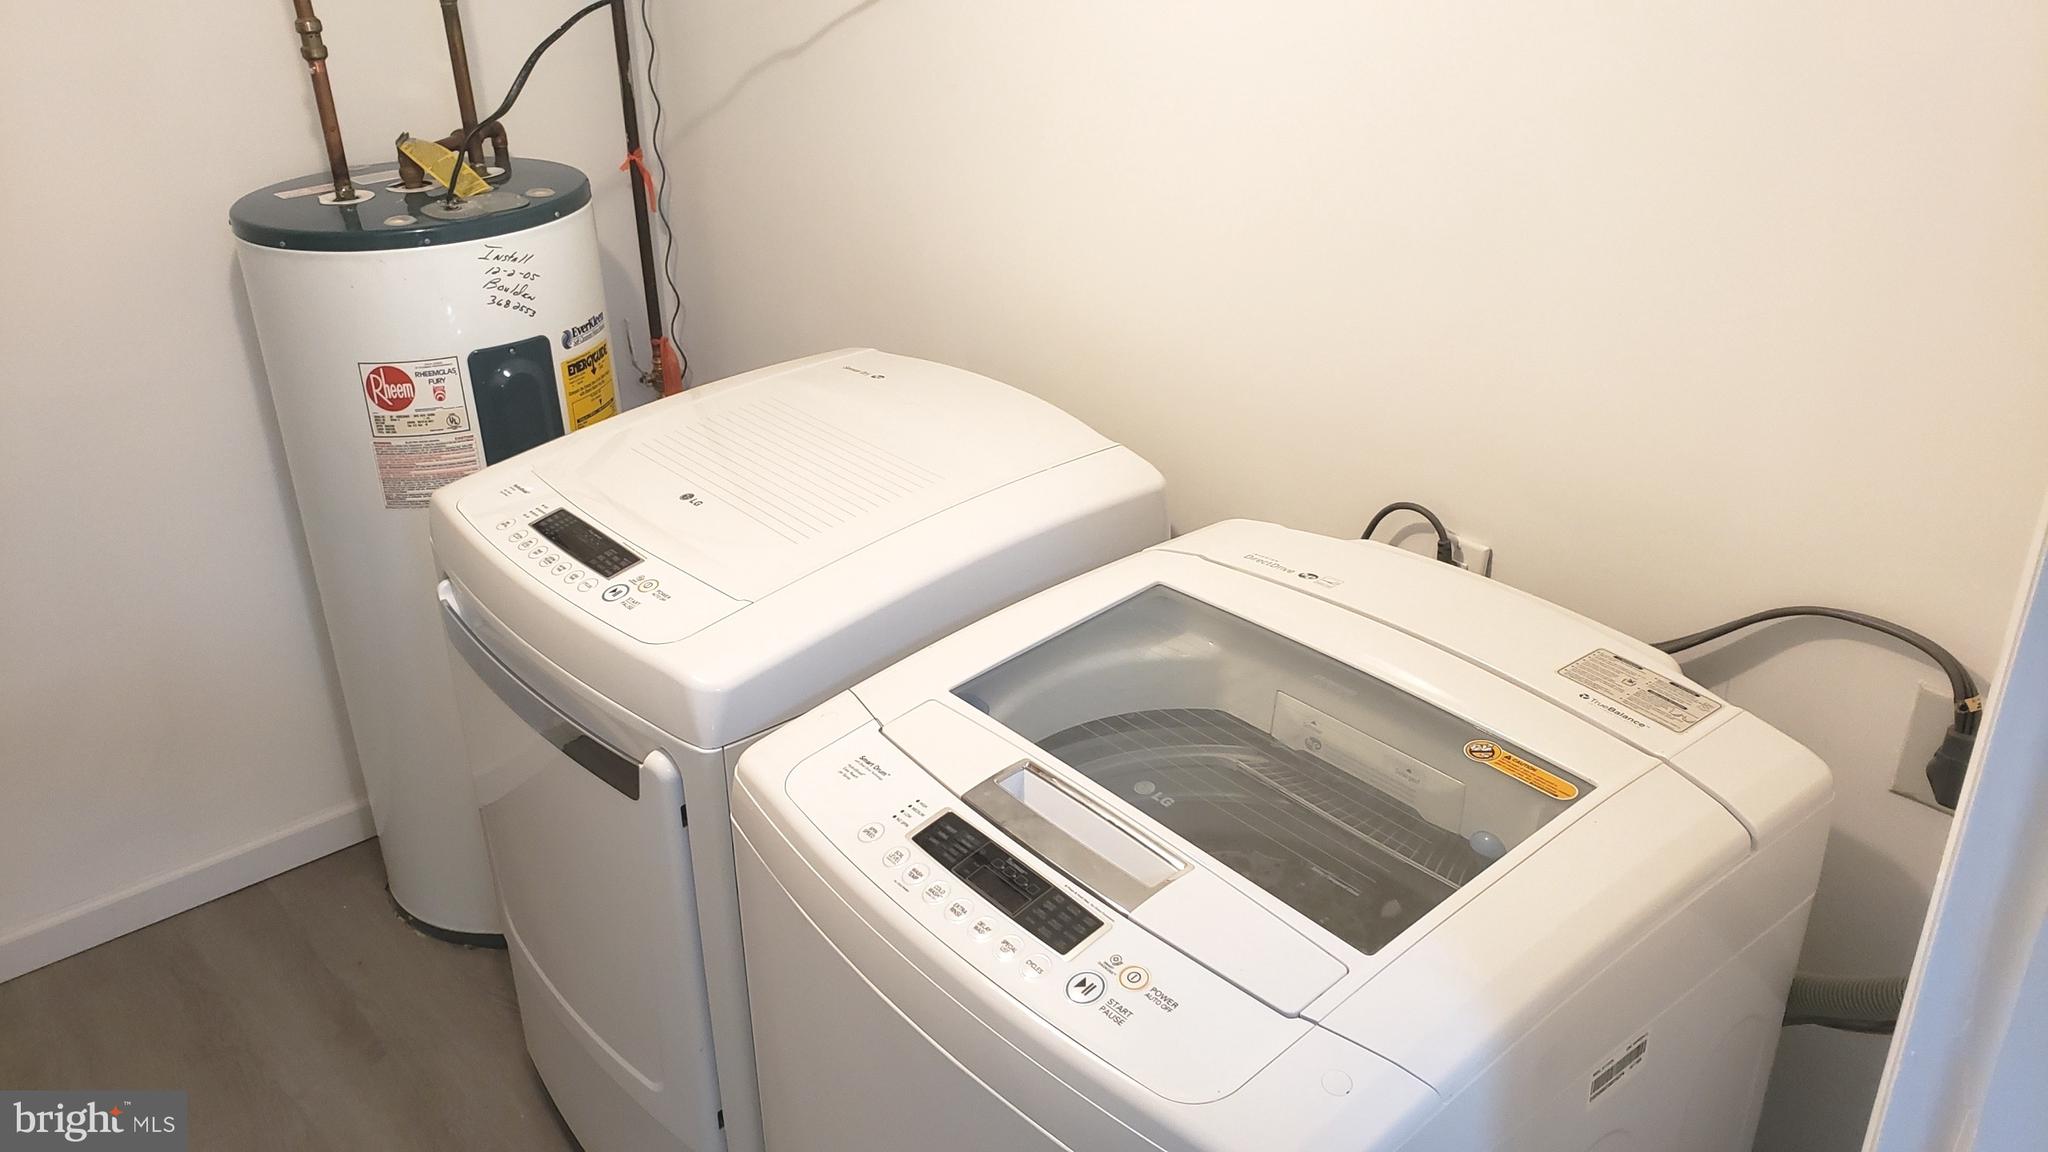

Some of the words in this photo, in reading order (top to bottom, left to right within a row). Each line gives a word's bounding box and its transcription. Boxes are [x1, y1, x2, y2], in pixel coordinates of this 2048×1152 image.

[478, 244, 534, 264] Install
[484, 266, 540, 281] 12-2-05
[369, 367, 415, 406] Rheem
[428, 377, 446, 385] FURY
[689, 499, 704, 507] LG
[1590, 697, 1646, 729] TrueBalance
[1512, 759, 1538, 773] CAUTION
[1152, 791, 1175, 807] LG
[1144, 992, 1162, 1006] AUTO
[1160, 1002, 1173, 1013] OFF
[1149, 986, 1179, 1009] POWER
[1098, 1005, 1126, 1026] PAUSE
[1107, 998, 1134, 1018] START
